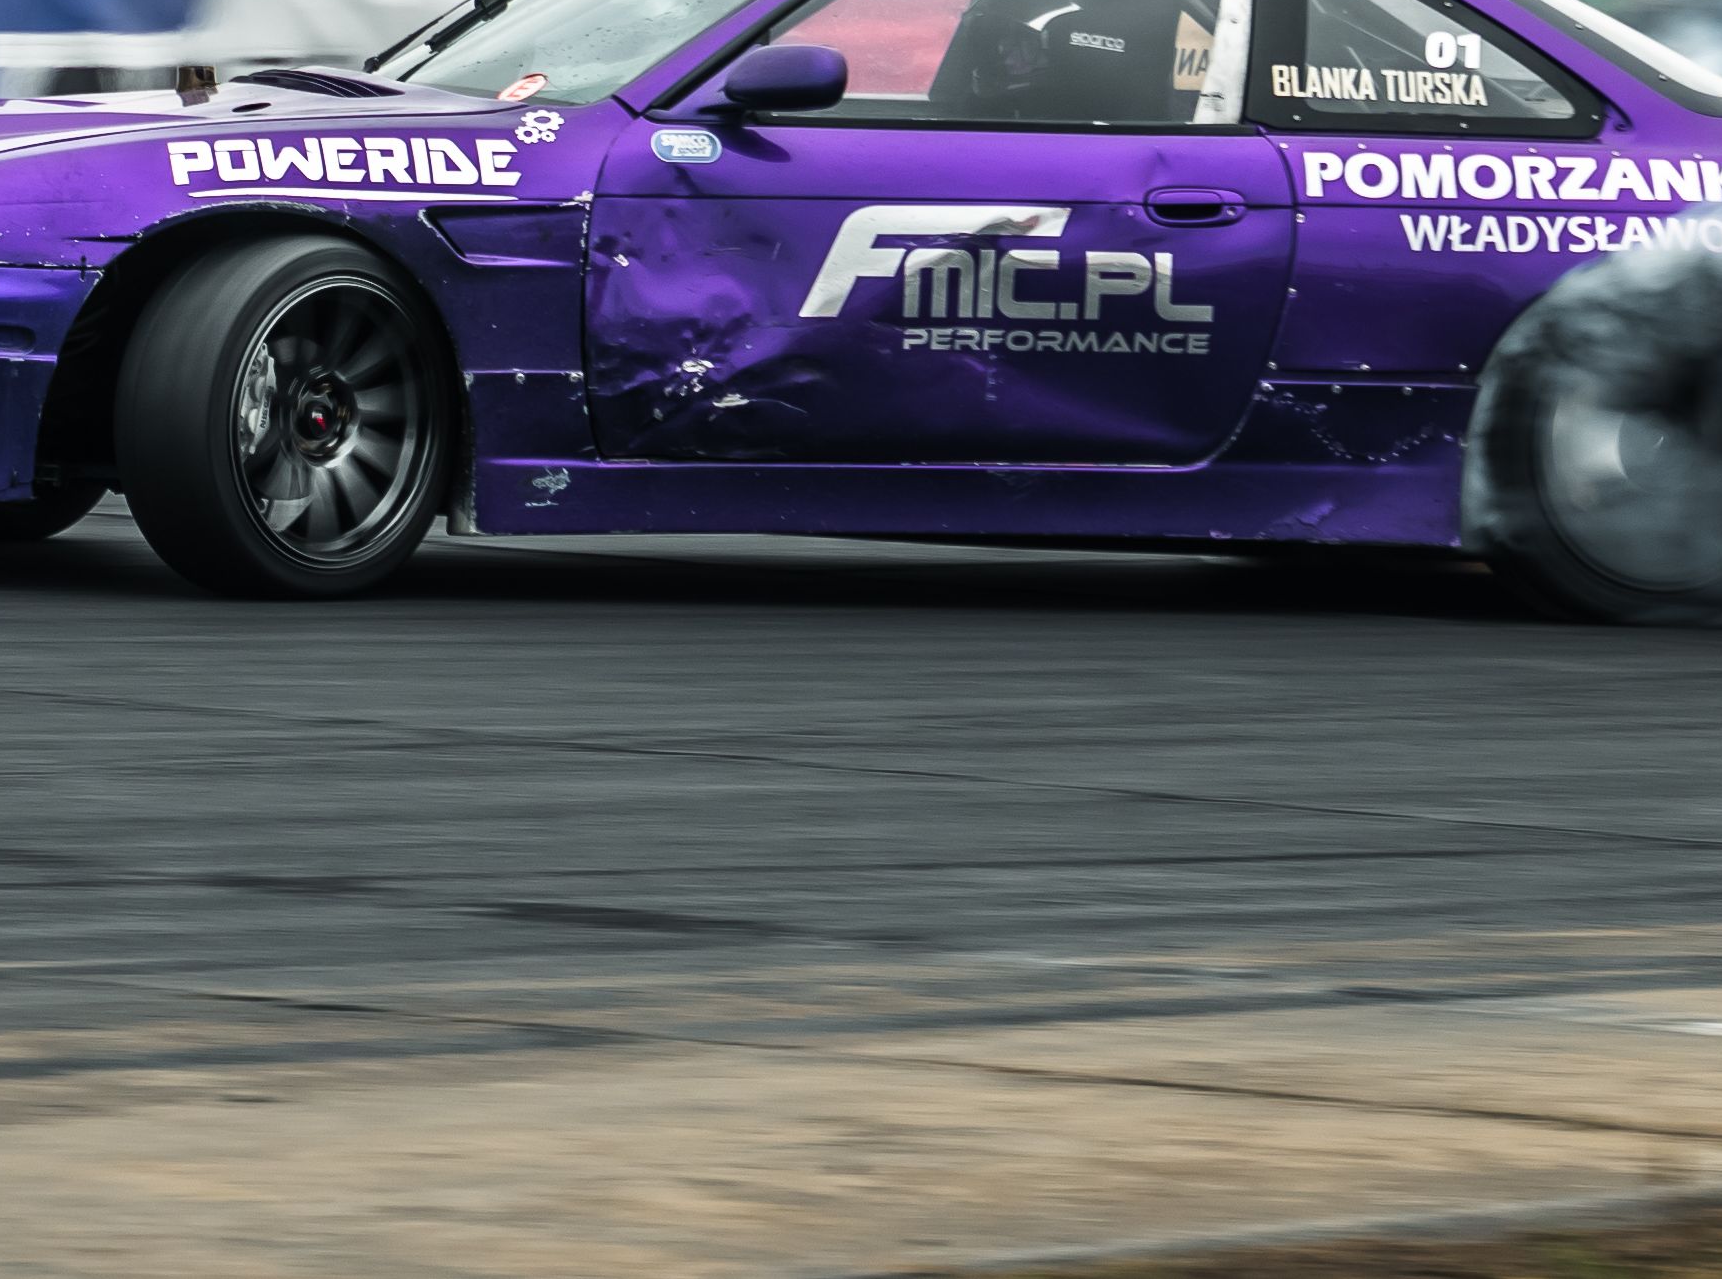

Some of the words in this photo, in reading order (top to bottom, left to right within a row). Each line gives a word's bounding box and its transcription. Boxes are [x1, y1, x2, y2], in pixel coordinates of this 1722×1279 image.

[1426, 31, 1481, 69] 01
[1271, 64, 1377, 101] BLANKA
[1381, 69, 1489, 107] TURSKA
[167, 137, 522, 186] POWERIDE
[903, 328, 1210, 354] PERFORMANCE
